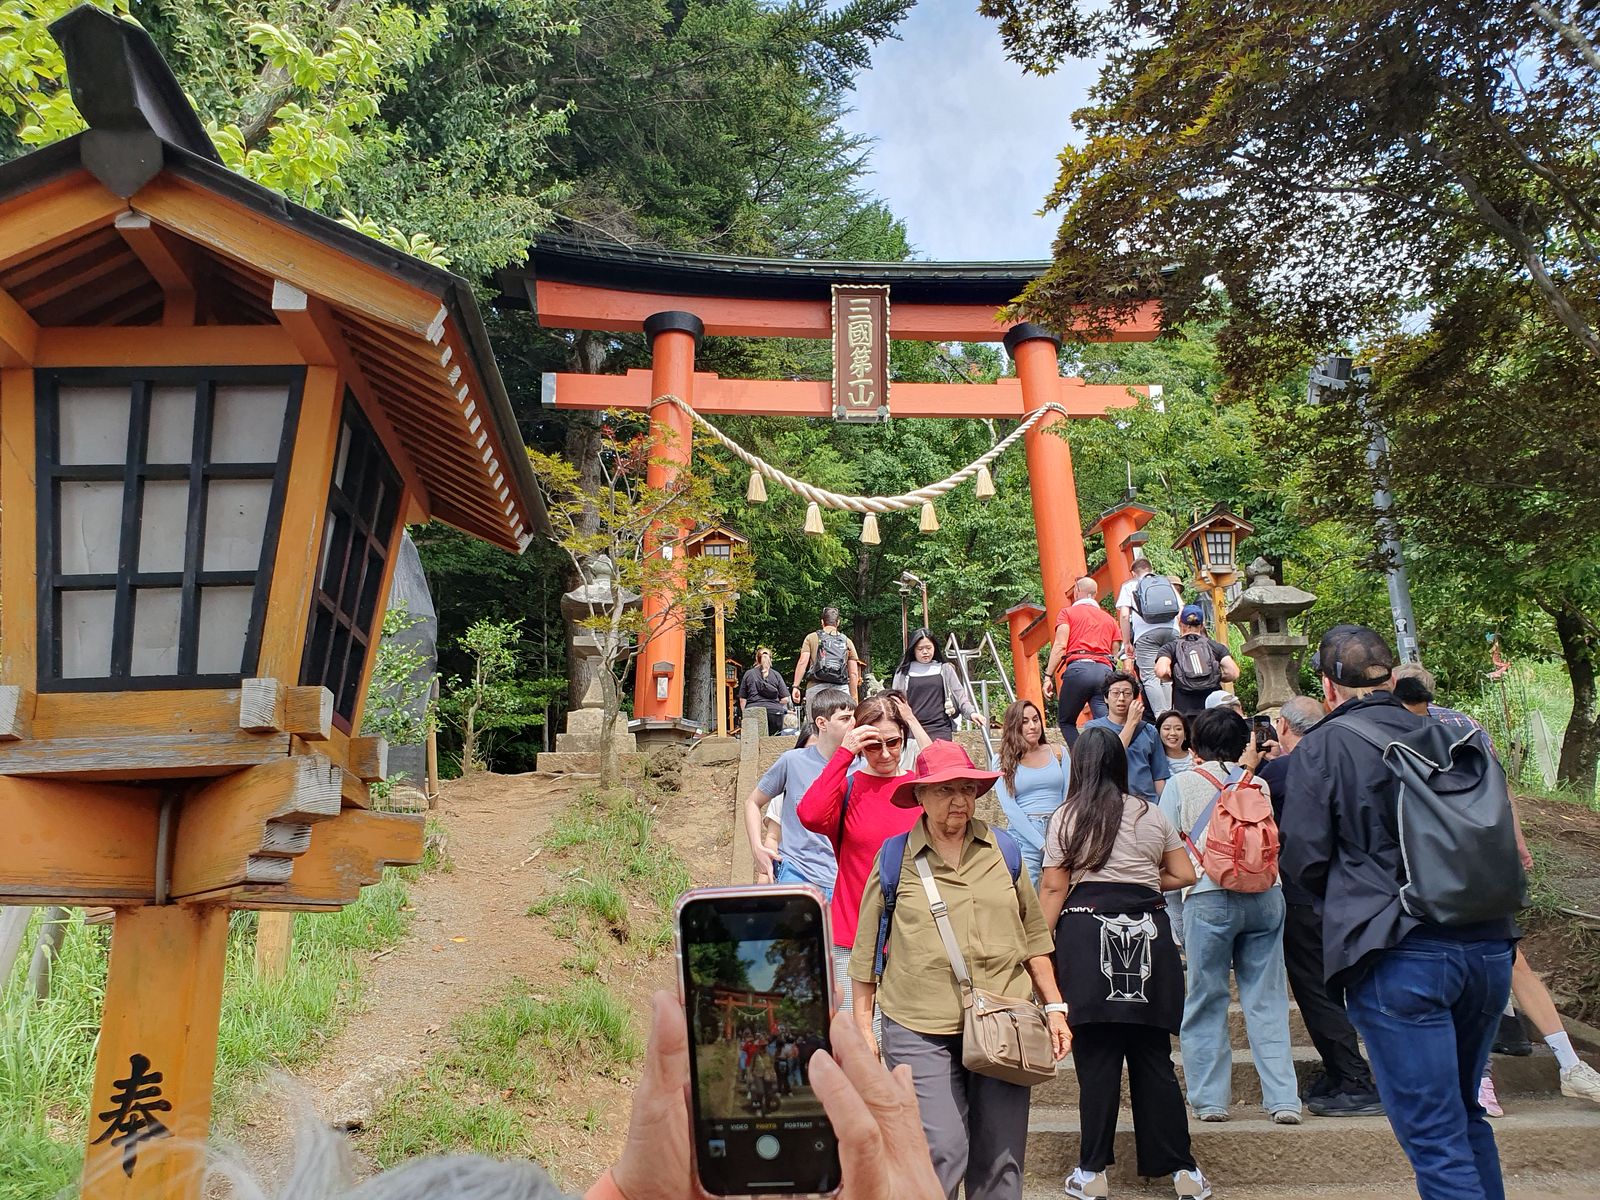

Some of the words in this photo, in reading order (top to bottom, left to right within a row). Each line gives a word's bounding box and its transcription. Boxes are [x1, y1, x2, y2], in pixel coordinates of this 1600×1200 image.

[847, 298, 875, 407] 三國第一山
[90, 1053, 175, 1179] 奉
[783, 1121, 814, 1129] PORTRAIT
